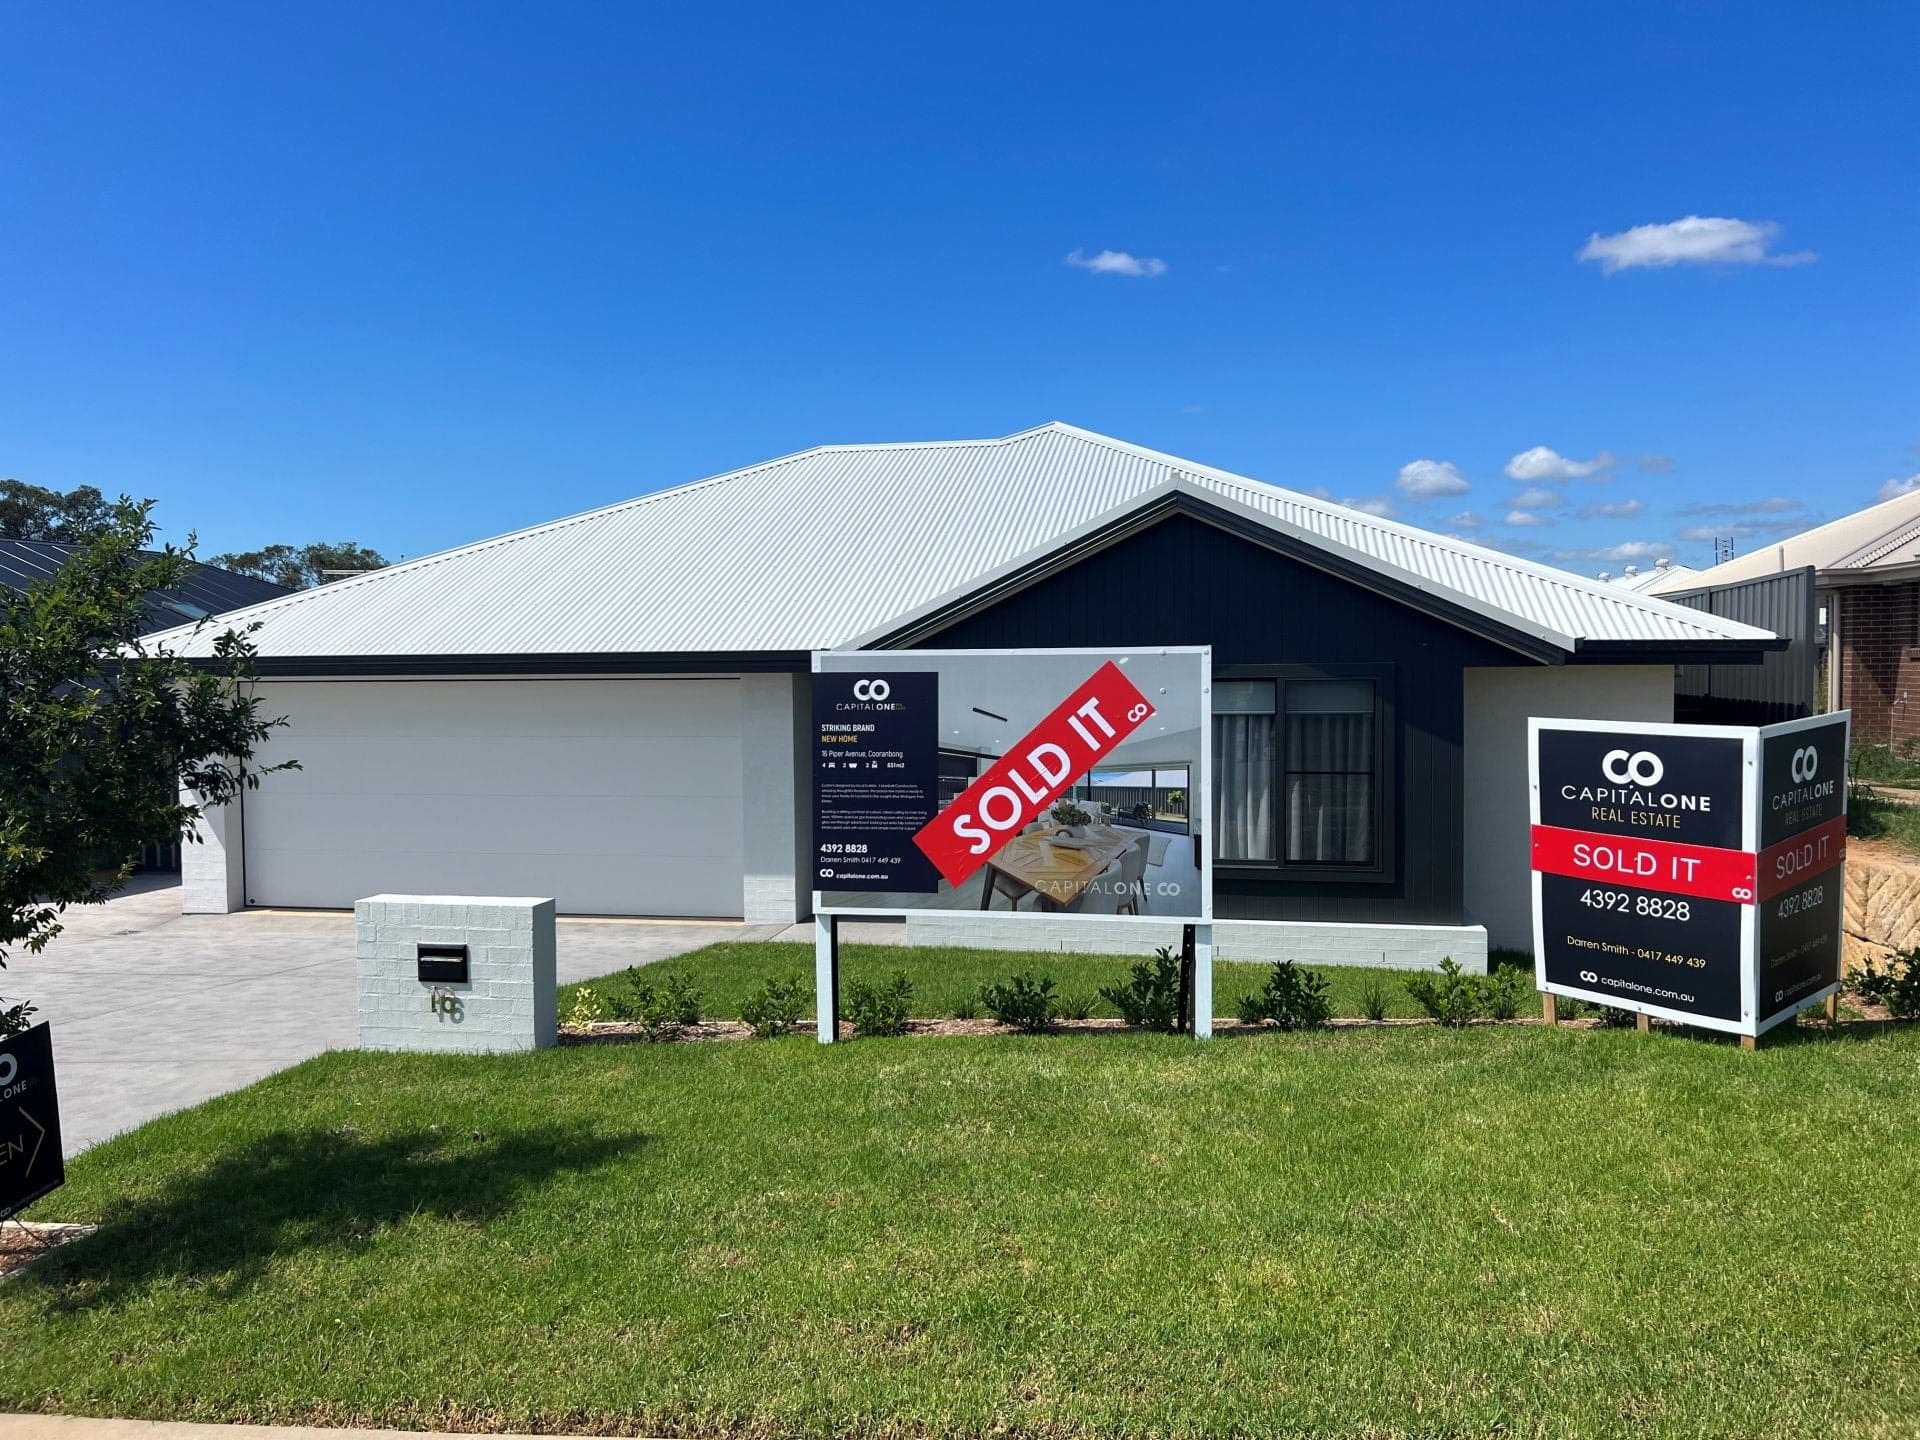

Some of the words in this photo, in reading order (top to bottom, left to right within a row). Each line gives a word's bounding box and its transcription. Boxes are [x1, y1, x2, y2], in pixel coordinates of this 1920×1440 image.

[836, 703, 896, 711] CAPITALONE
[821, 724, 851, 732] STRIKING
[852, 724, 875, 732] BRAND
[821, 735, 837, 743] NEW
[838, 735, 858, 743] HOME
[868, 750, 904, 760] Cooranbong
[953, 743, 1071, 855] SOLD
[1067, 697, 1116, 751] IT
[1561, 785, 1711, 812] CAPITALONE
[1772, 779, 1834, 811] CAPITALONE
[1591, 807, 1625, 823] REAL
[1631, 811, 1681, 829] ESTATE
[820, 844, 843, 853] 4392
[845, 844, 868, 853] 8828
[820, 856, 842, 864] Darren
[843, 856, 860, 864] Smith
[861, 856, 876, 864] 0417
[890, 857, 901, 865] 439
[1776, 843, 1813, 880] SOLD
[1818, 835, 1829, 860] IT
[1573, 844, 1657, 876] SOLD
[1672, 856, 1701, 882] IT
[836, 872, 889, 880] capitalone.com.au
[1034, 879, 1151, 896] CAPITALONE
[1579, 888, 1630, 913] 4392
[1635, 896, 1690, 922] 8828
[1778, 894, 1800, 918] 4392
[1802, 885, 1824, 911] 8828
[1567, 935, 1600, 951] Darren
[1602, 941, 1629, 956] Smith
[1637, 948, 1662, 962] 0417
[1664, 953, 1683, 965] 449
[1686, 957, 1706, 969] 439
[1600, 974, 1694, 1002] capitalone.com.au
